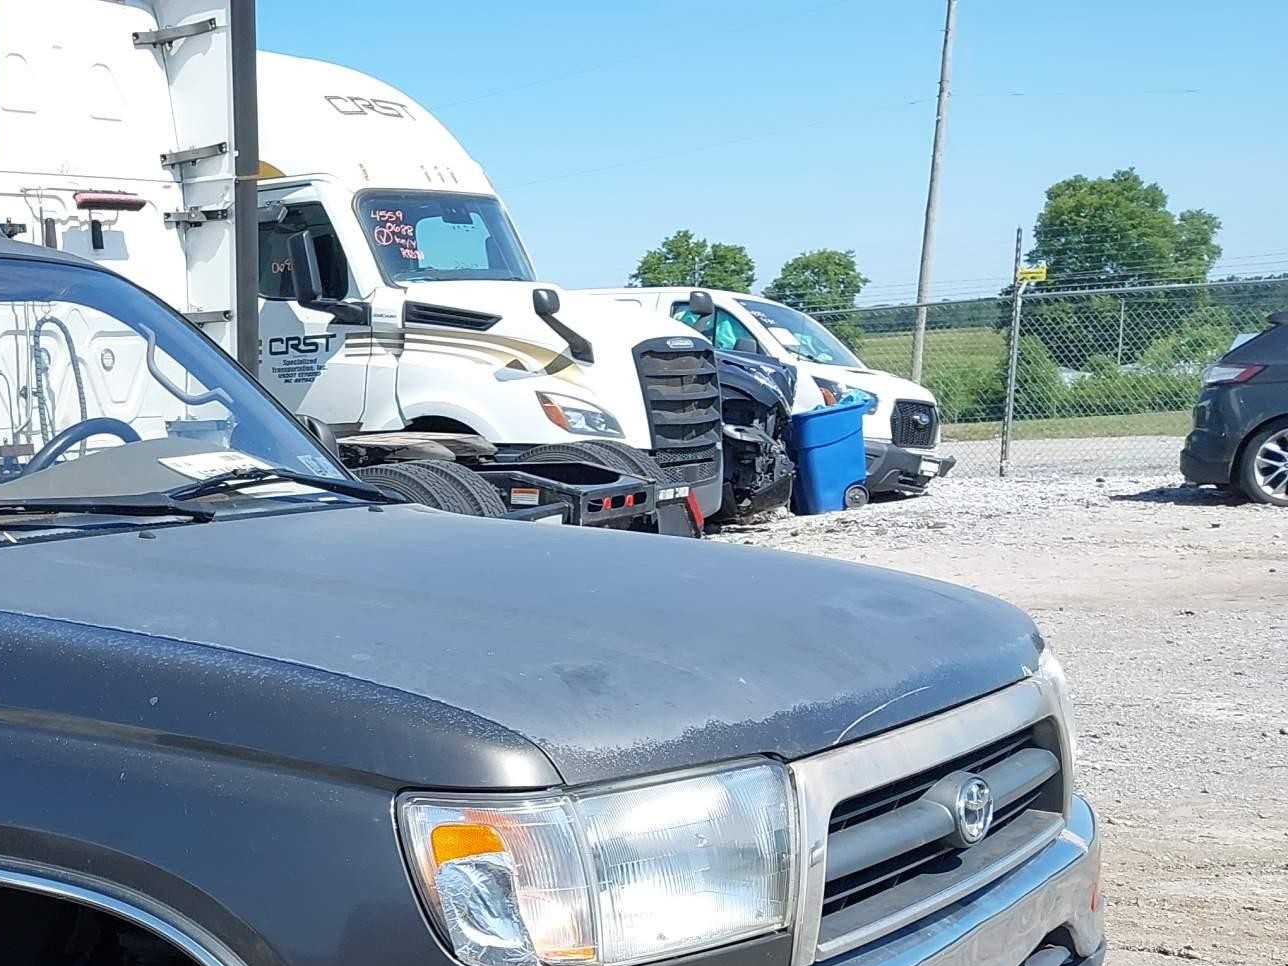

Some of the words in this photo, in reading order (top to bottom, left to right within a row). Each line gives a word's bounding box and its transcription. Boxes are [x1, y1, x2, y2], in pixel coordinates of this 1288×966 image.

[324, 95, 416, 121] CRST
[370, 209, 403, 221] 4559
[269, 333, 337, 356] CRST
